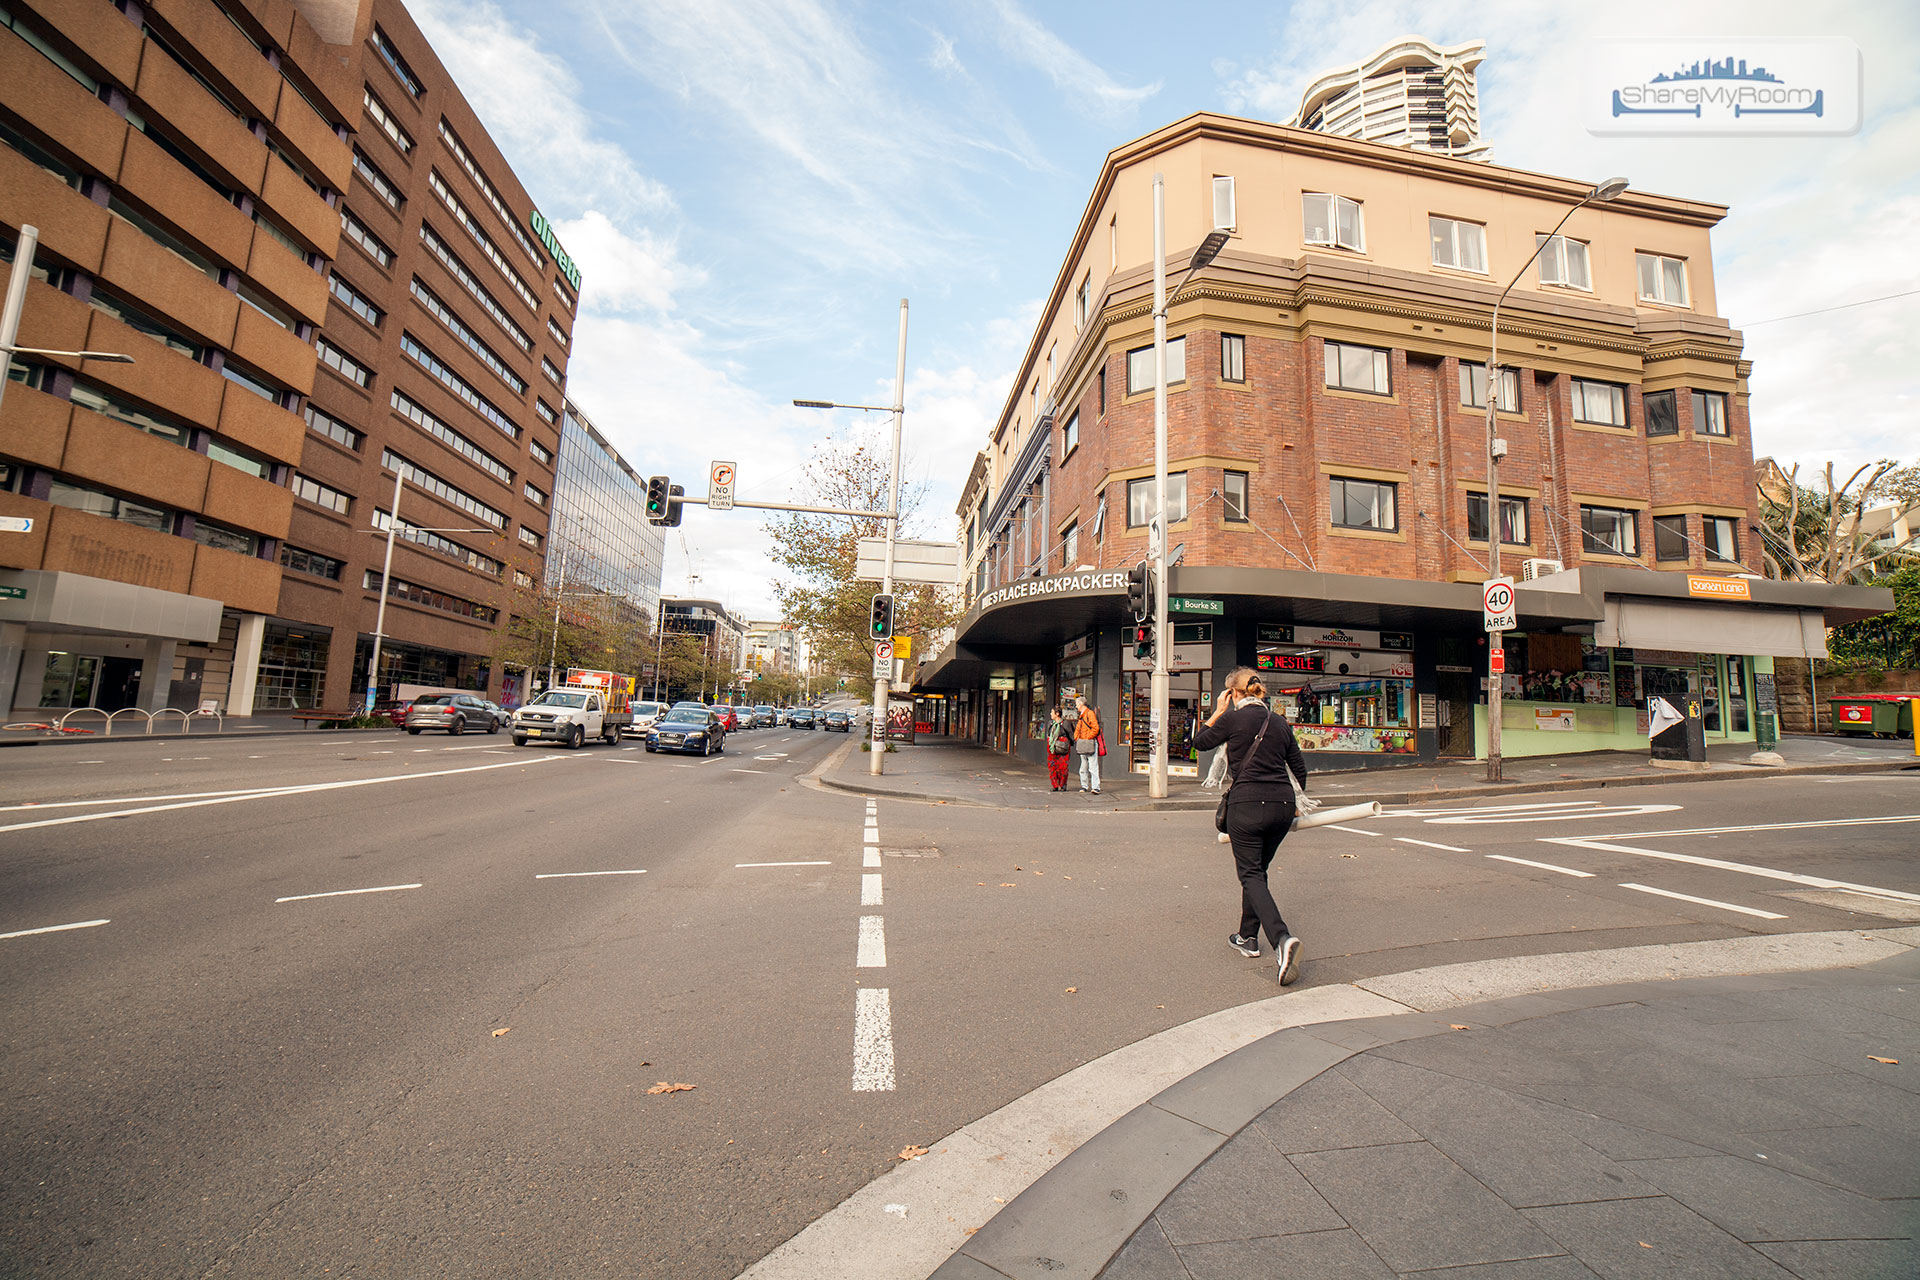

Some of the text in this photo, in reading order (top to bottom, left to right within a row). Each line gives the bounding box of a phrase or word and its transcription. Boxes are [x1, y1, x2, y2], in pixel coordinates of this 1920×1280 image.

[530, 210, 582, 293] olivetti
[715, 486, 729, 494] NO
[998, 583, 1028, 602] PLACE
[1488, 590, 1509, 606] 40
[1184, 600, 1218, 610] Bourke St
[1485, 616, 1515, 628] AREA
[1322, 634, 1354, 643] HORIZON
[1274, 656, 1315, 670] NESTLE
[1391, 663, 1412, 676] ICE
[1303, 727, 1411, 738] Pies Ice Fruit
